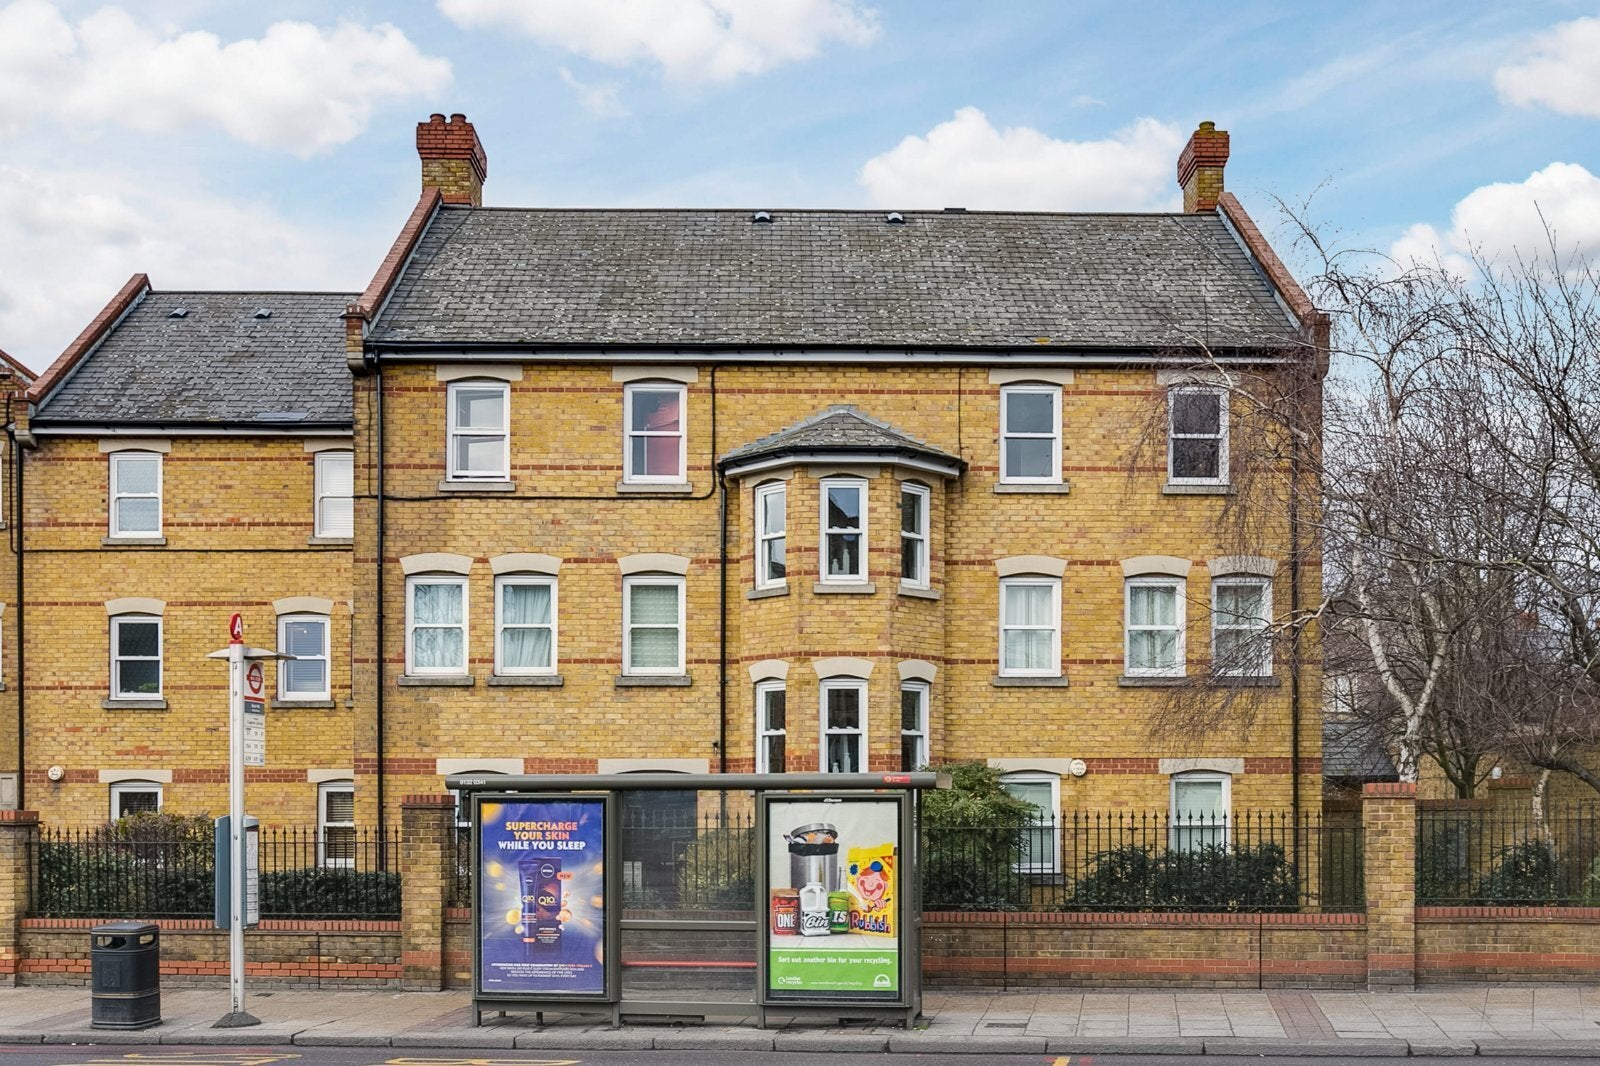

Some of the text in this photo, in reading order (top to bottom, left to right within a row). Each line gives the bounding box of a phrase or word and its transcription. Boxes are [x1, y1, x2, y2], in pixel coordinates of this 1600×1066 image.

[233, 617, 242, 636] A
[505, 822, 578, 831] SUPERCHARGE
[514, 832, 570, 840] YOUR SKIN
[498, 841, 586, 850] WHILE YOU SLEEP
[538, 896, 555, 905] Q10
[777, 914, 795, 927] ONE
[804, 916, 830, 928] Bin
[850, 910, 891, 933] Rubbish
[849, 958, 862, 966] your
[864, 957, 892, 966] recycling.
